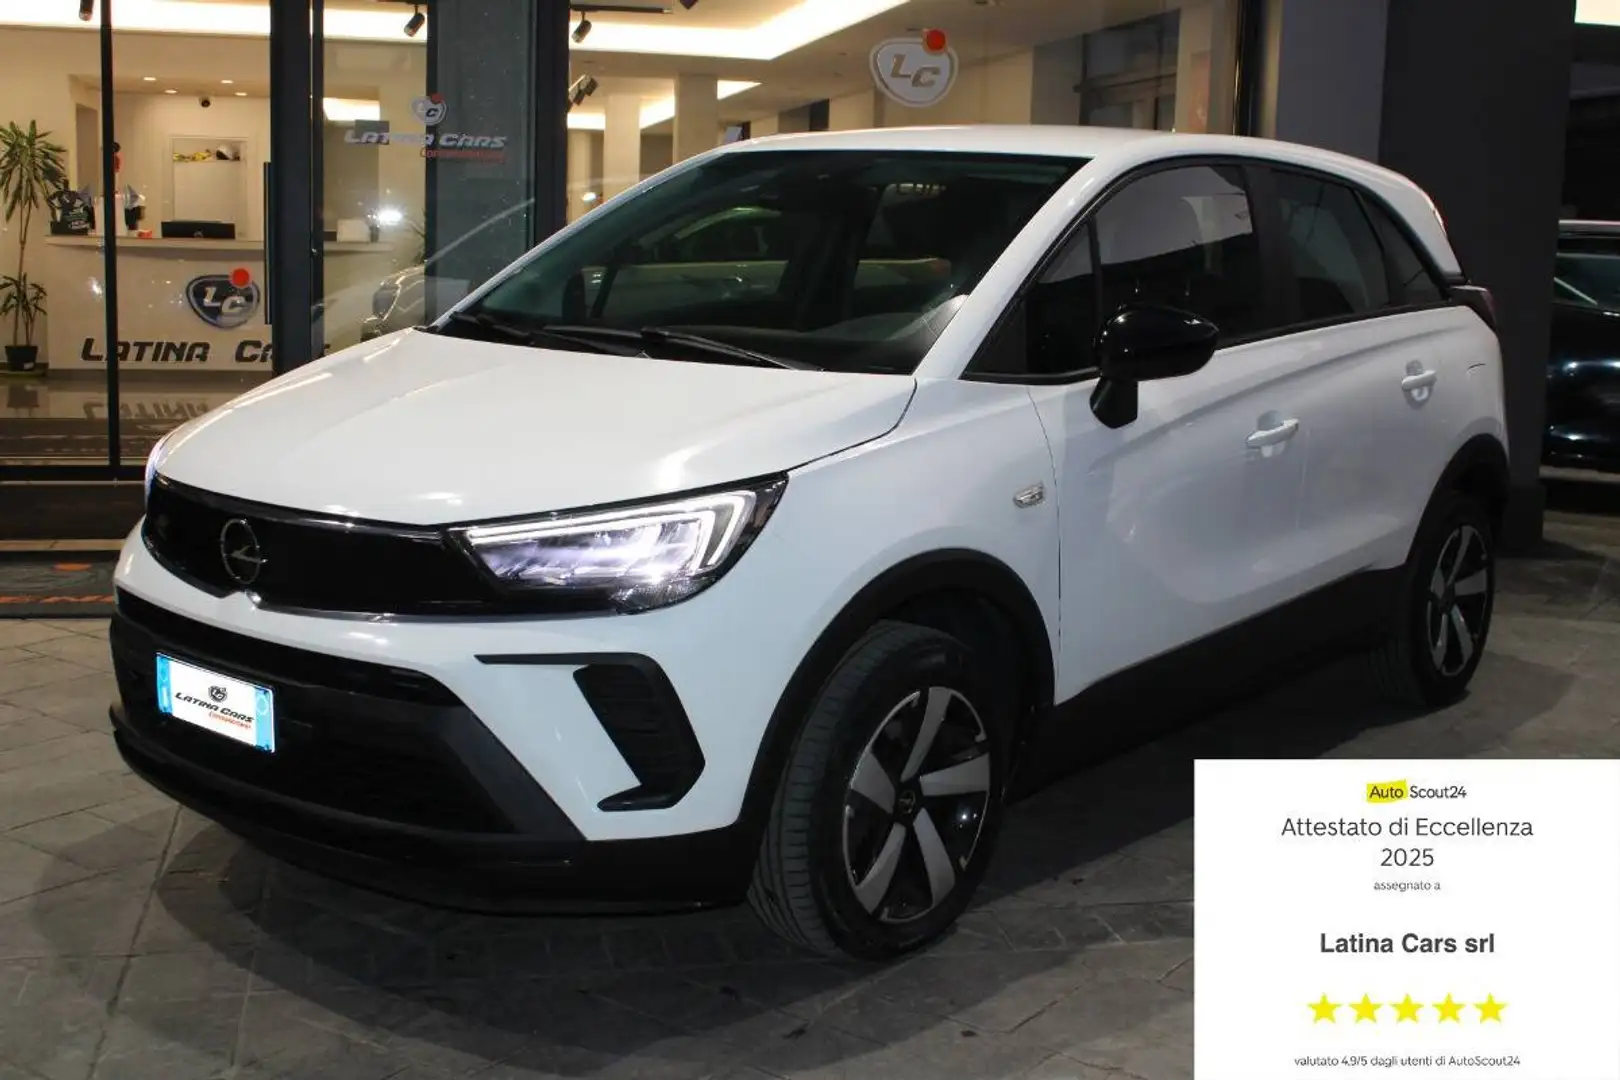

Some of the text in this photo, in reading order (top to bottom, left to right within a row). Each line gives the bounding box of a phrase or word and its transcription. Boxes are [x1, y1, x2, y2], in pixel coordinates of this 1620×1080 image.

[890, 52, 941, 88] LC
[343, 129, 434, 146] LATA
[80, 338, 210, 362] LATINA
[175, 692, 219, 712] LATINA
[220, 707, 255, 723] CARS
